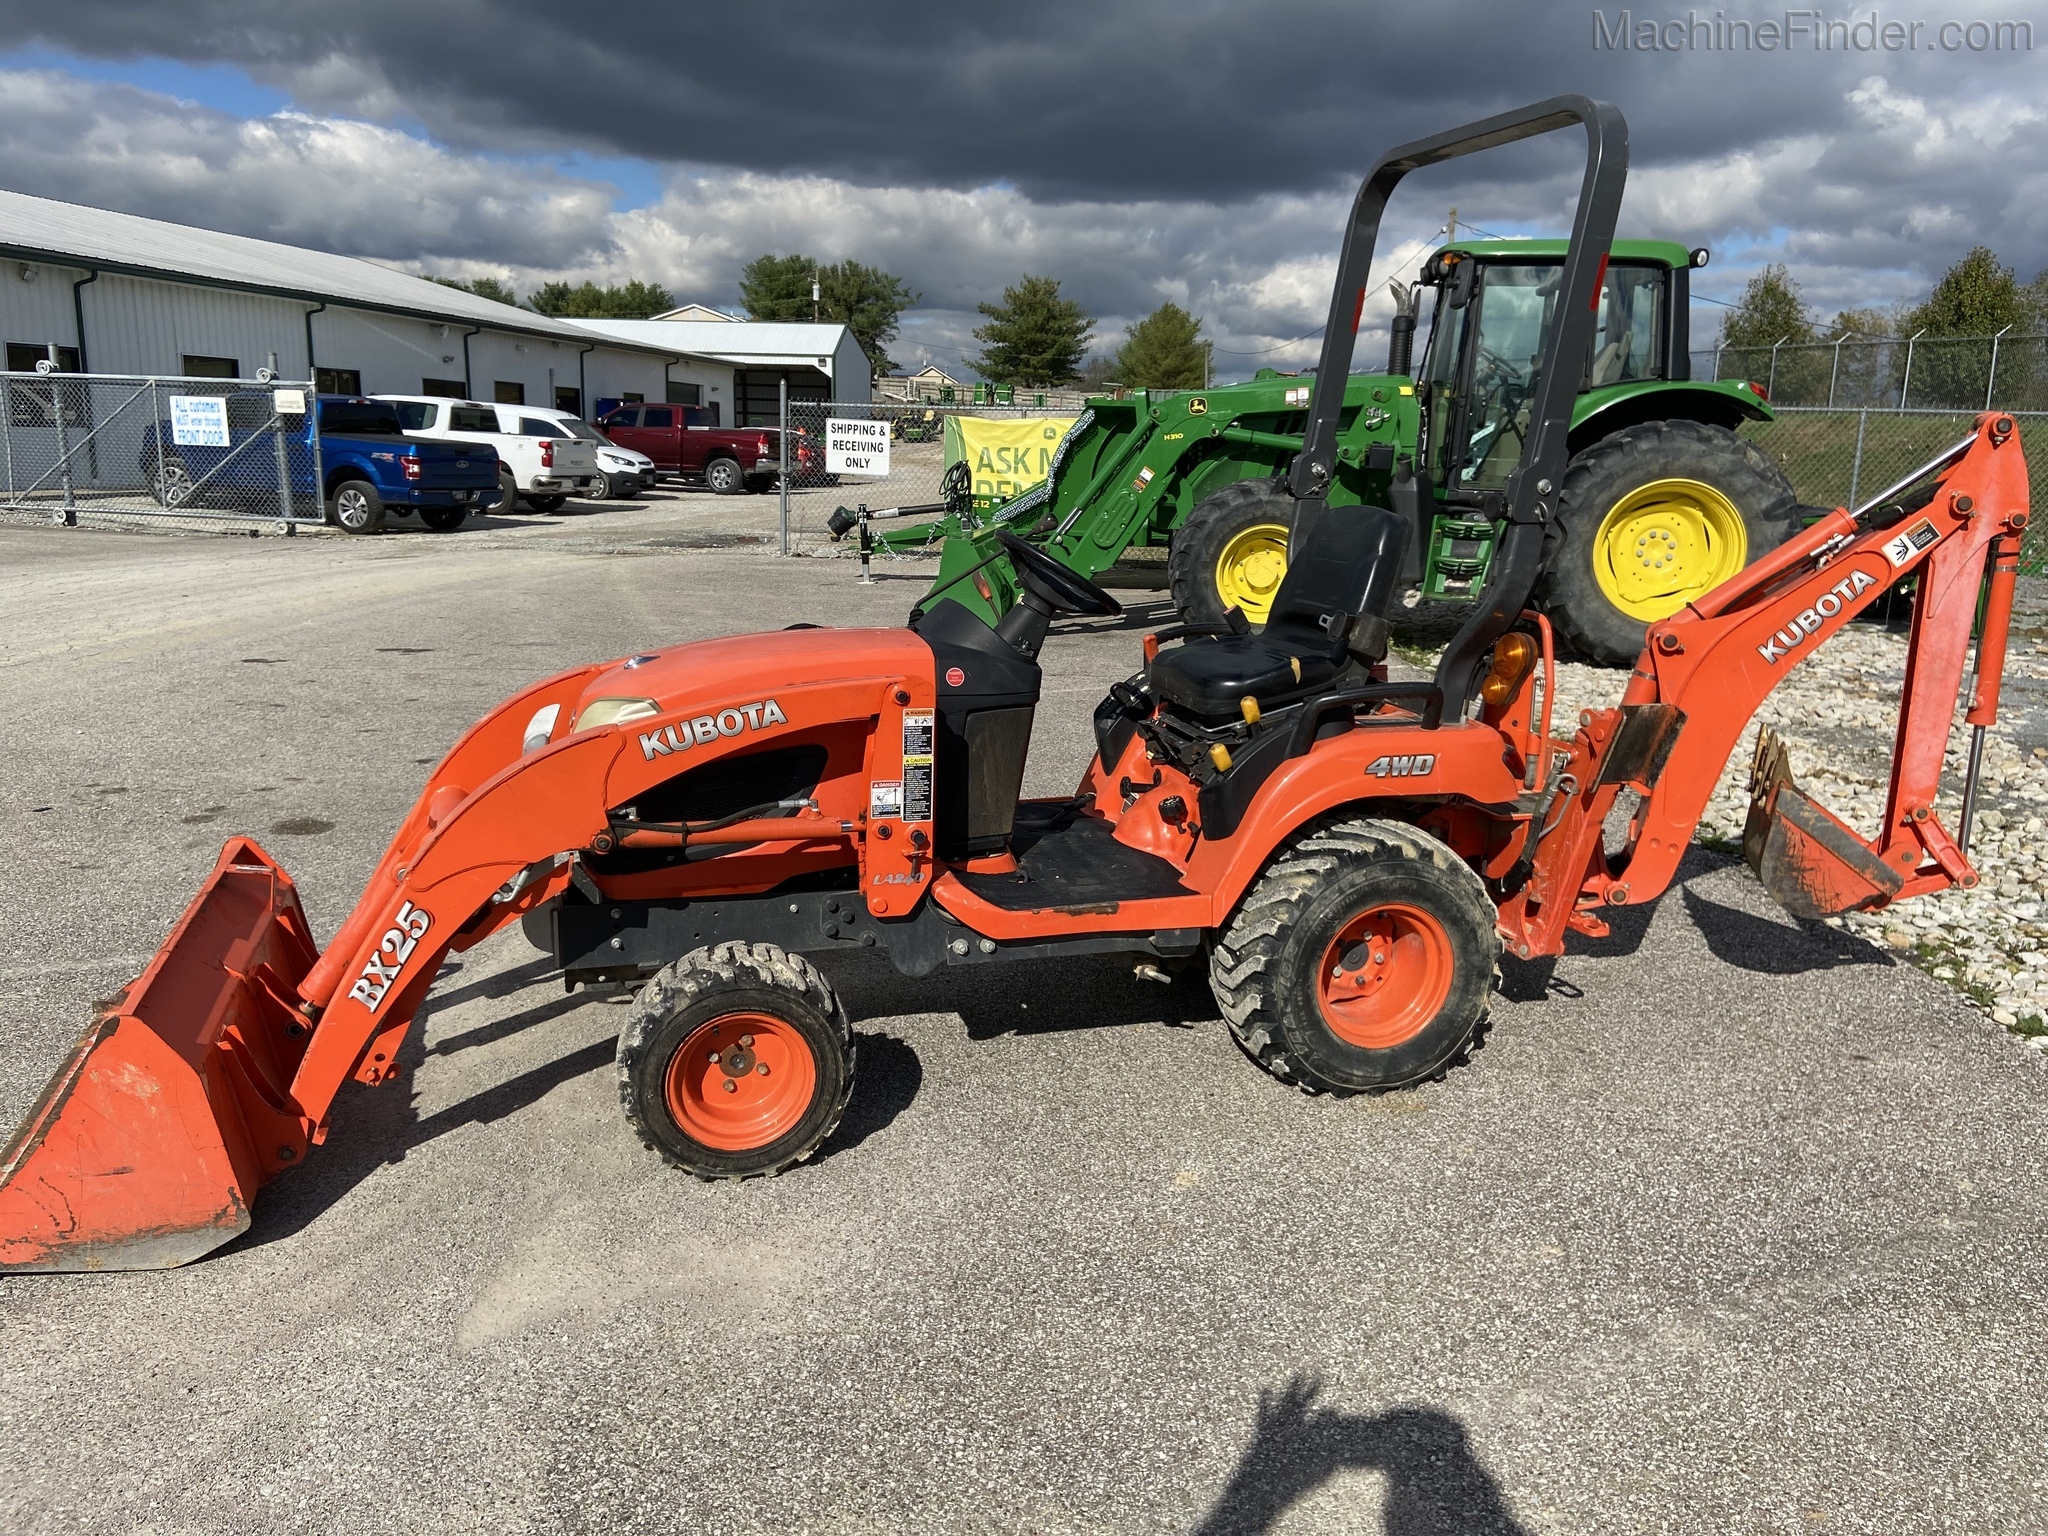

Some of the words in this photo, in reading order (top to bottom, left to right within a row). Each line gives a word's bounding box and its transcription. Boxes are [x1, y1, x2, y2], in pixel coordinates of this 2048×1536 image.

[175, 397, 187, 412] ALL
[190, 400, 220, 412] customers
[175, 414, 189, 426] MUST
[178, 429, 200, 443] FRONT
[203, 430, 224, 445] DOOR
[831, 423, 876, 436] SHIPPING
[879, 425, 886, 436] &
[832, 440, 884, 453] RECEIVING
[845, 457, 870, 469] ONLY
[975, 446, 1031, 475] ASK
[1757, 568, 1878, 665] KUBOTA
[638, 698, 788, 761] KUBOTA
[1365, 754, 1435, 778] 4WD
[348, 899, 432, 1014] BX25
